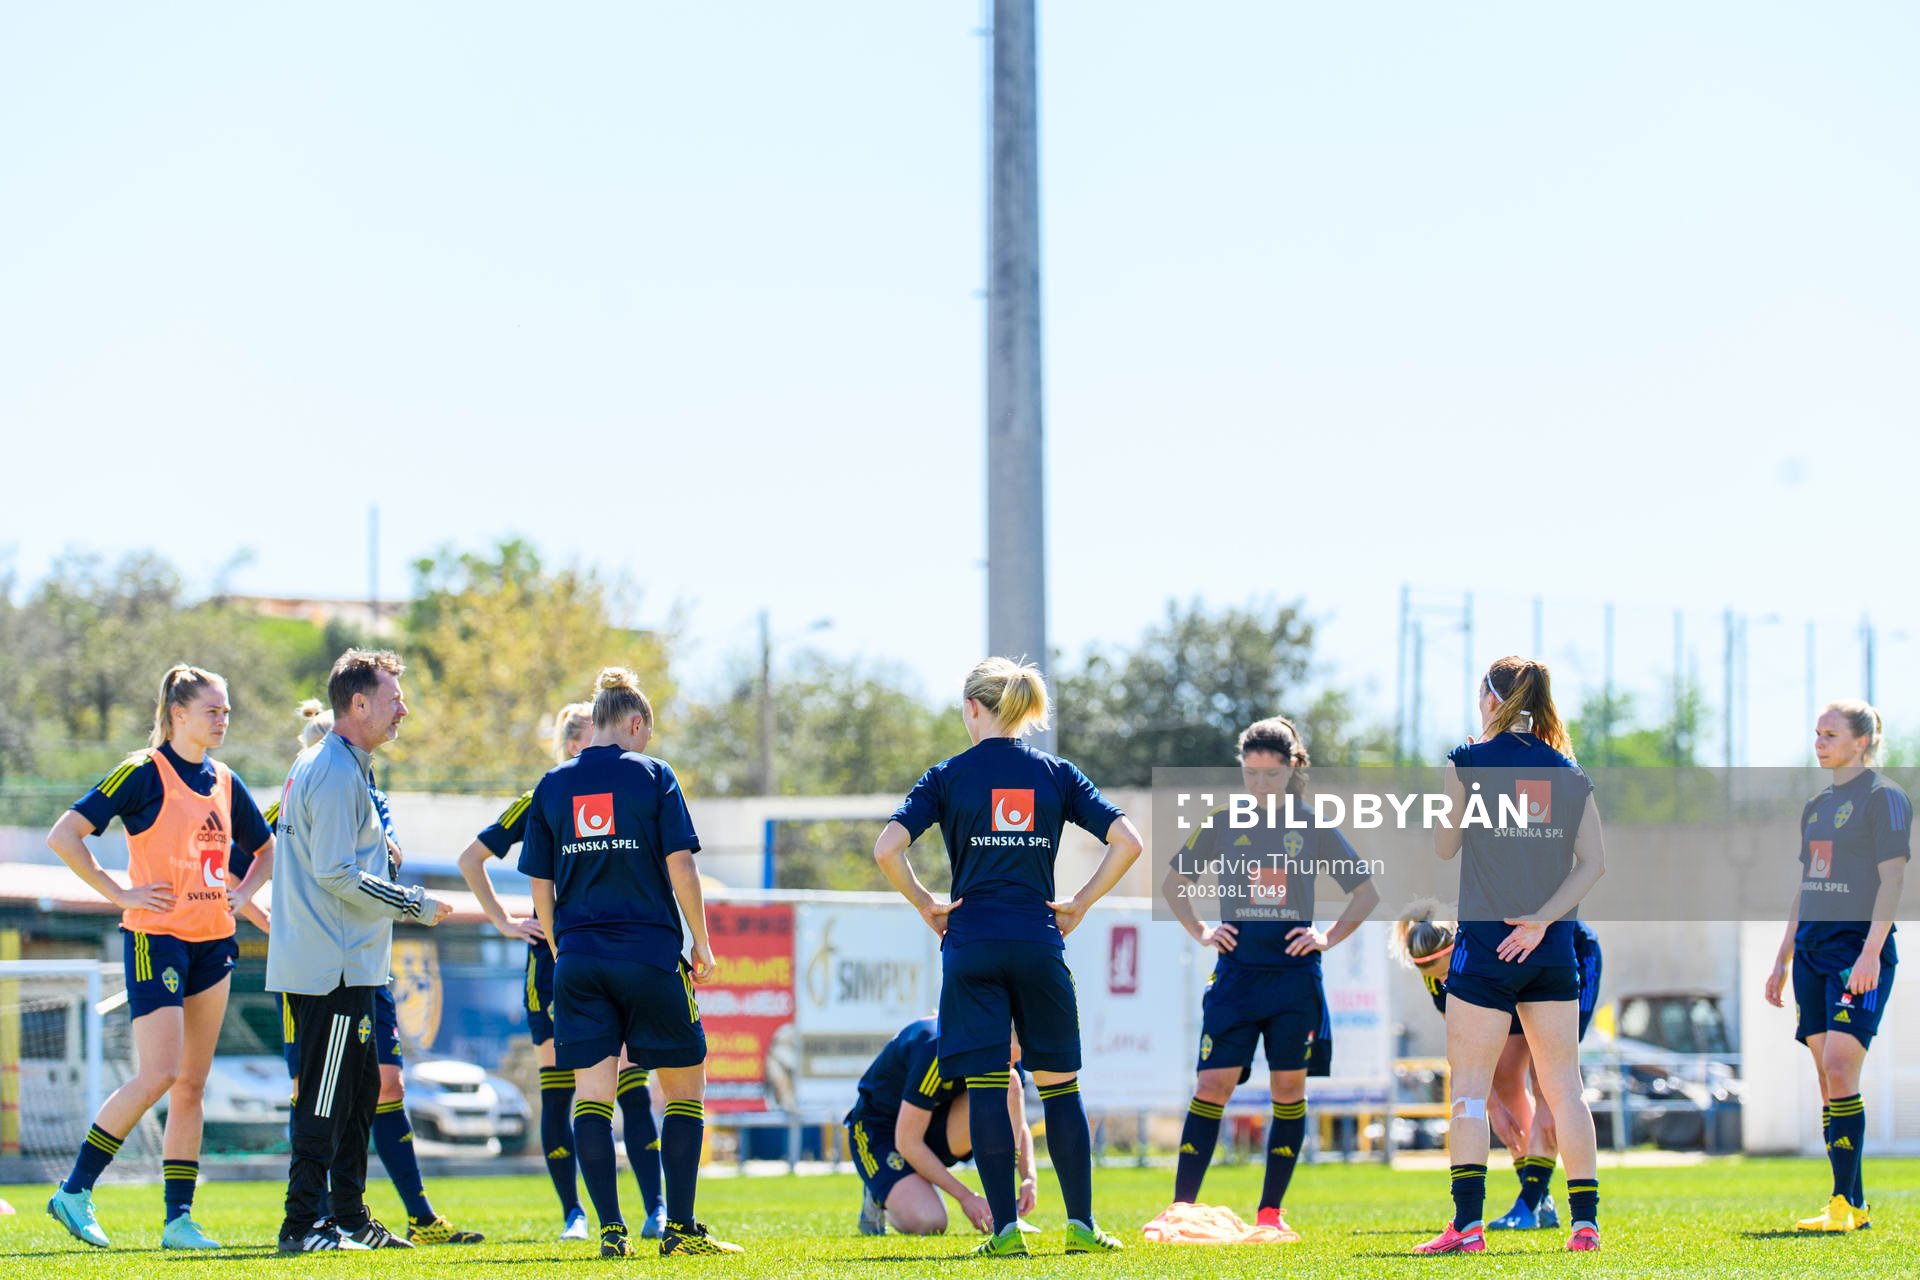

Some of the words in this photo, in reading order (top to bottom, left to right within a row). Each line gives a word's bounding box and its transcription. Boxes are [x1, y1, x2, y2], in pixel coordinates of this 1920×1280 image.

[1494, 827, 1542, 838] SVENSKA
[970, 836, 1025, 847] SVENSKA
[561, 840, 609, 856] SVENSKA
[611, 839, 639, 850] SPEL
[1824, 882, 1850, 893] SPEL
